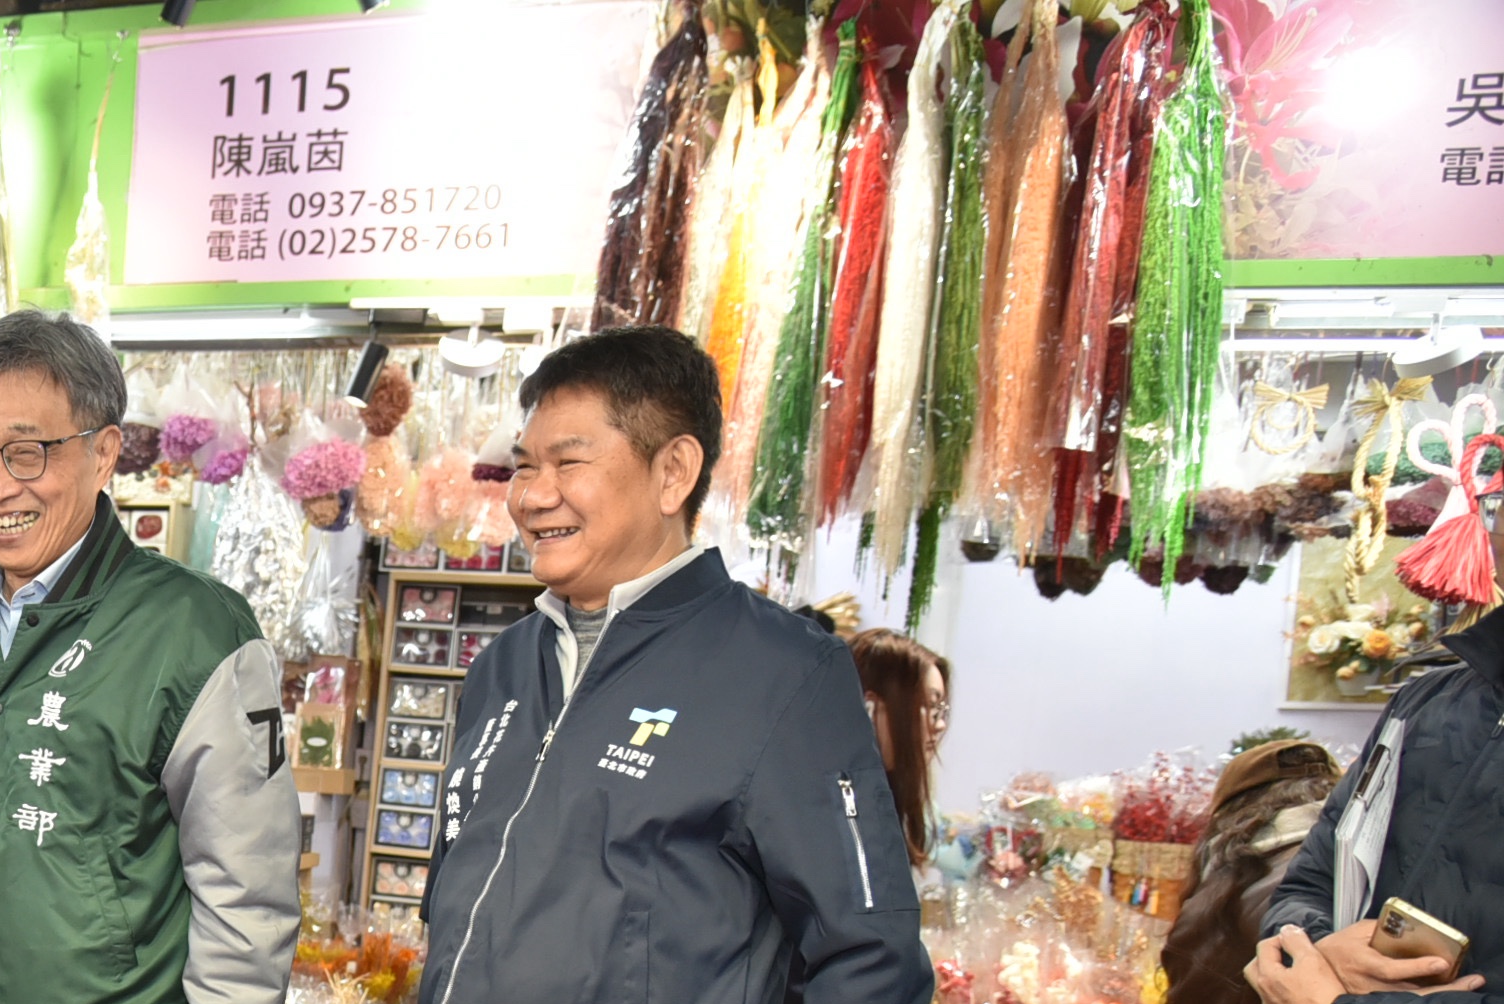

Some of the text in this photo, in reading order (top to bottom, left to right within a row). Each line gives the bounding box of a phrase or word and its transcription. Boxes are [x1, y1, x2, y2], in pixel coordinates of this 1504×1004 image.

[219, 67, 351, 117] 1115
[1445, 72, 1504, 127] 吳
[211, 128, 349, 179] 陳嵐茵
[208, 184, 502, 226] 電話 0937-851720
[207, 222, 509, 262] 電話 (02)2578-7661
[12, 690, 70, 847] 農業部
[606, 744, 655, 768] TAIPEI
